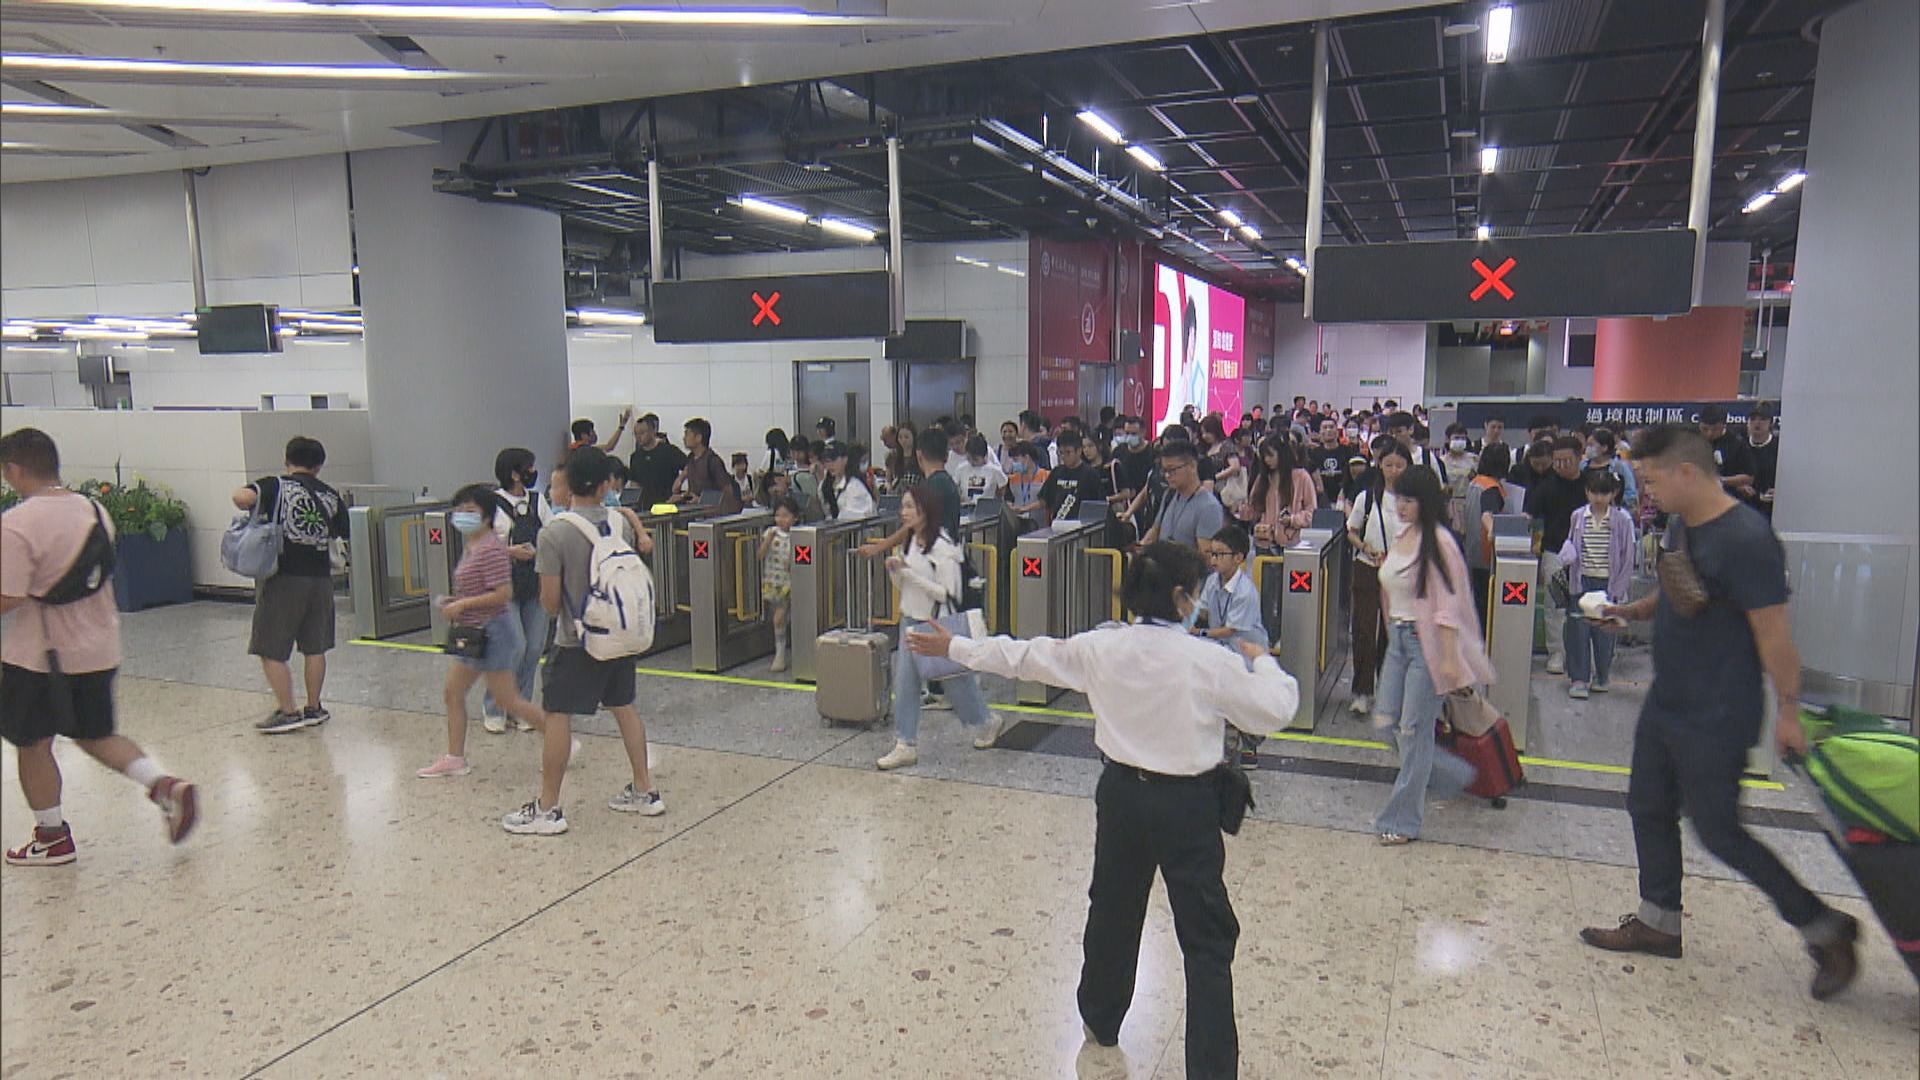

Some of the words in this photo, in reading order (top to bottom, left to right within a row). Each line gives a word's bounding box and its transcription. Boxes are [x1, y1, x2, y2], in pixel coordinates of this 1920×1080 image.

[1586, 407, 1684, 424] 過境限制區
